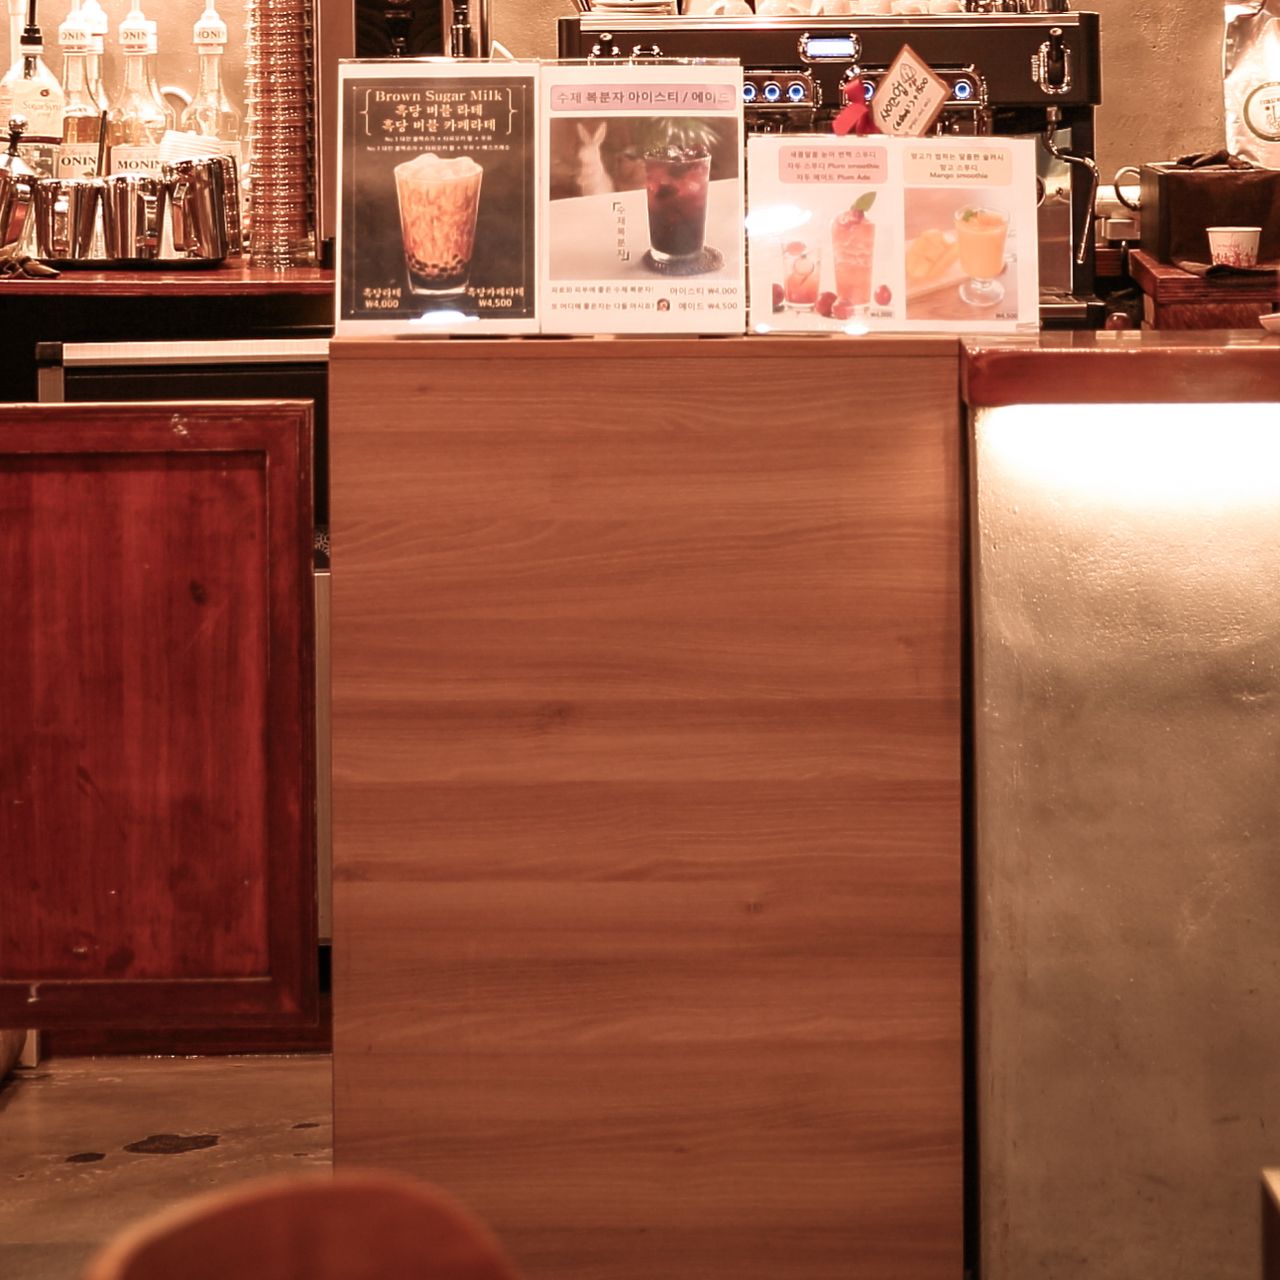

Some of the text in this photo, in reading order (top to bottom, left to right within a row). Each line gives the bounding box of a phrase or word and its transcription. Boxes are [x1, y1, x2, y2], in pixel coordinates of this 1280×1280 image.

[375, 89, 503, 103] Brown Sugar Milk
[586, 91, 624, 104] 복분자
[628, 91, 679, 104] 아이스티
